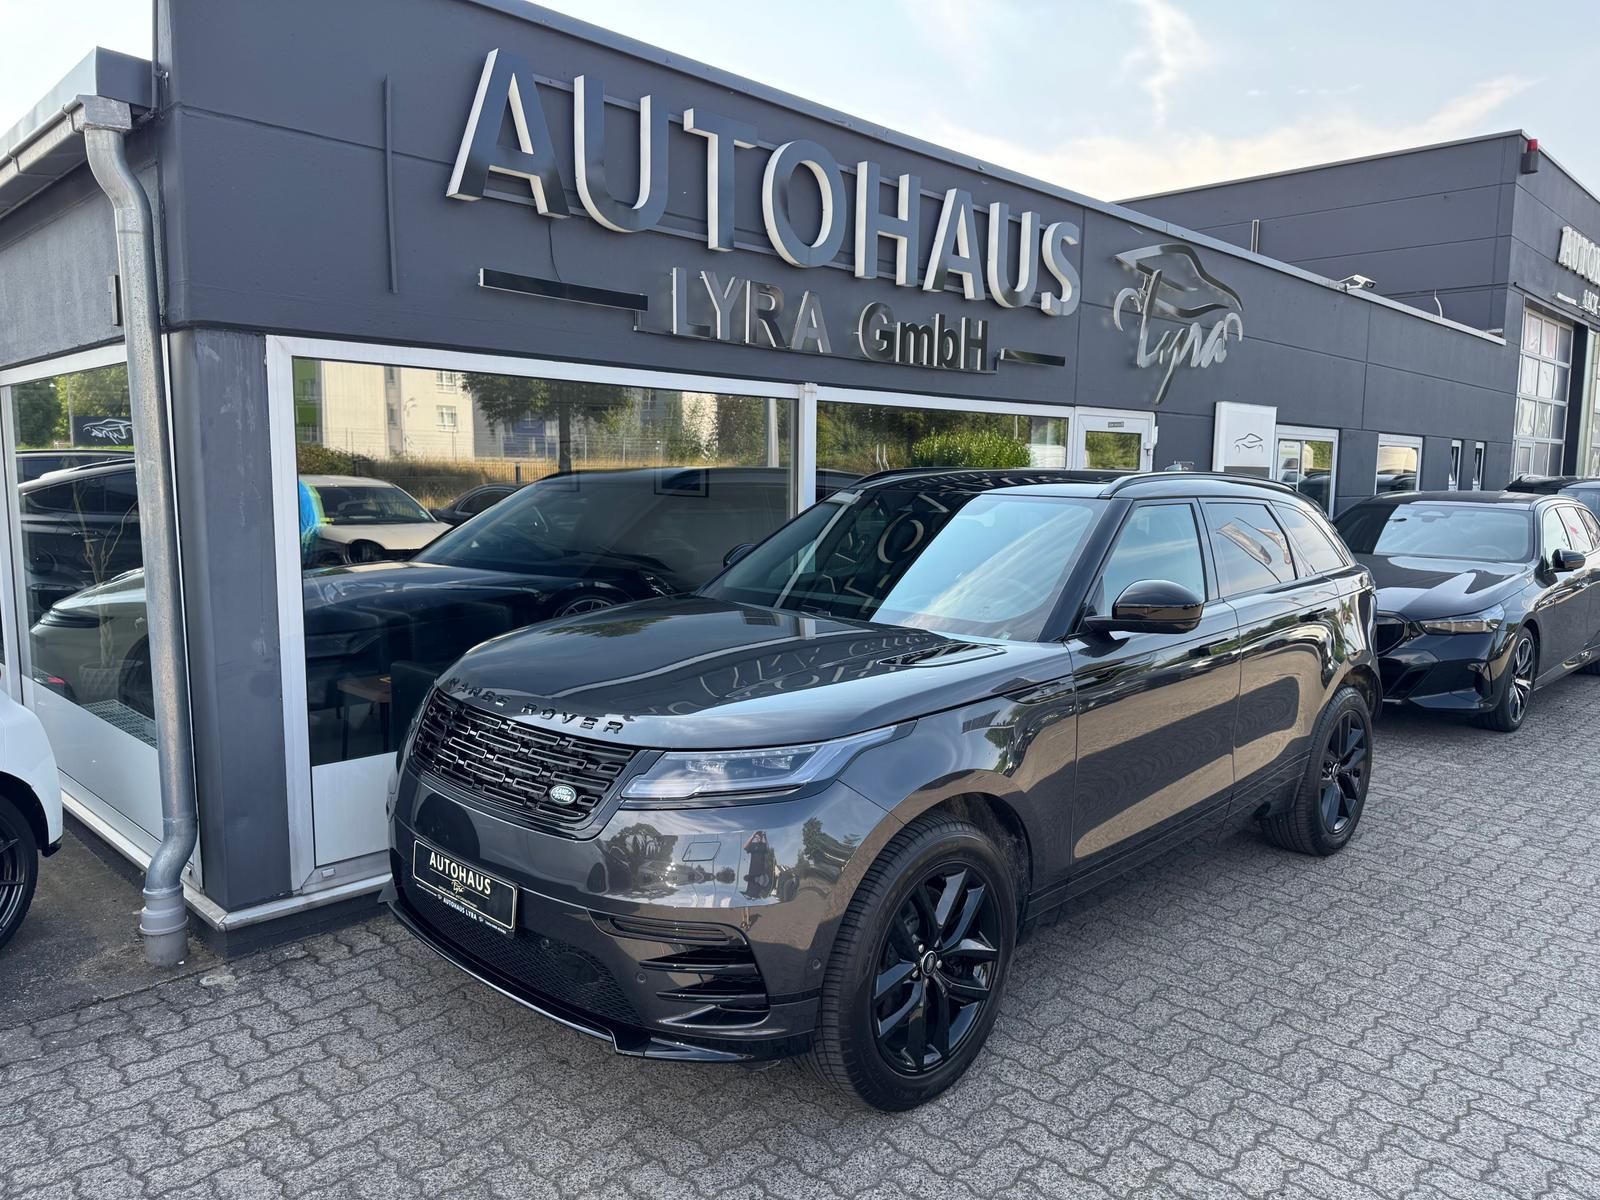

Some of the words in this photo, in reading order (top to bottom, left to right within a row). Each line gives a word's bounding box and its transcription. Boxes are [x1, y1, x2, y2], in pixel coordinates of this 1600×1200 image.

[446, 48, 1081, 317] AUTOHAUS
[671, 267, 832, 353] LYRA
[859, 301, 988, 371] GmbH
[521, 703, 624, 735] ROVER
[429, 852, 491, 895] AUTOHAUS
[443, 897, 465, 914] AUTOHAUS
[465, 909, 478, 921] LYRA
